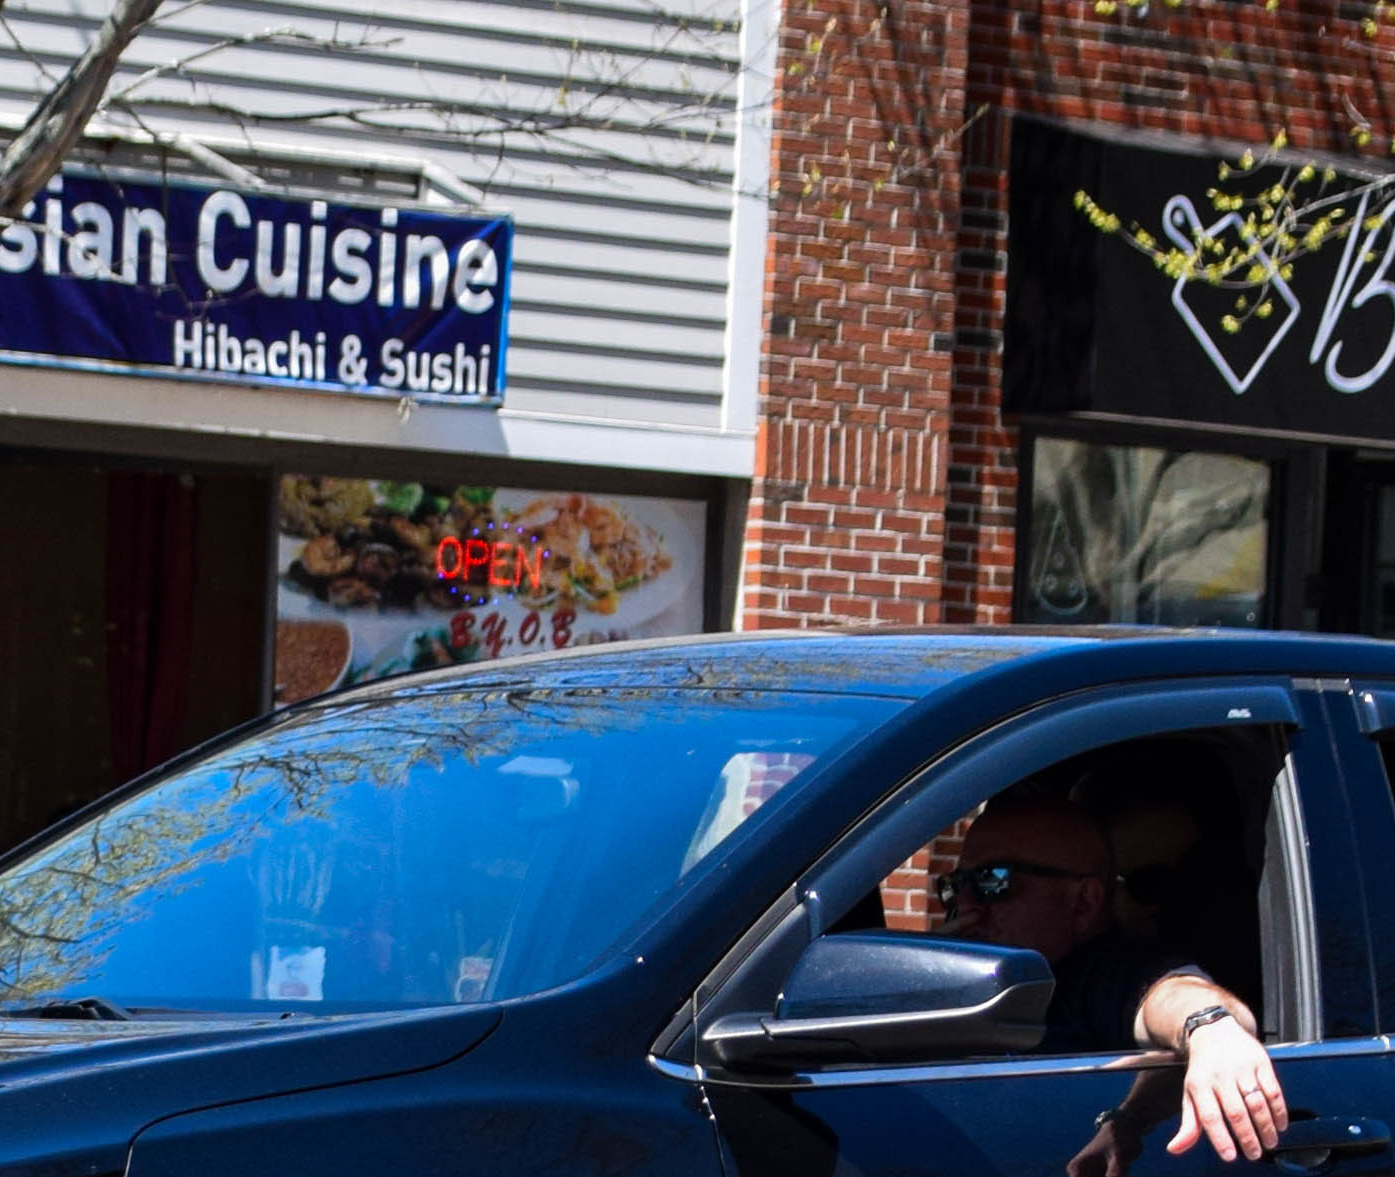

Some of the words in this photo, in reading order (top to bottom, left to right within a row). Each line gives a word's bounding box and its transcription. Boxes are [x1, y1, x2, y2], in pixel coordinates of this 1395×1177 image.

[198, 190, 498, 314] Cuisine
[174, 319, 326, 382] Hibachi
[338, 334, 368, 386] &
[380, 337, 491, 397] Sushi
[436, 536, 543, 589] OPEN
